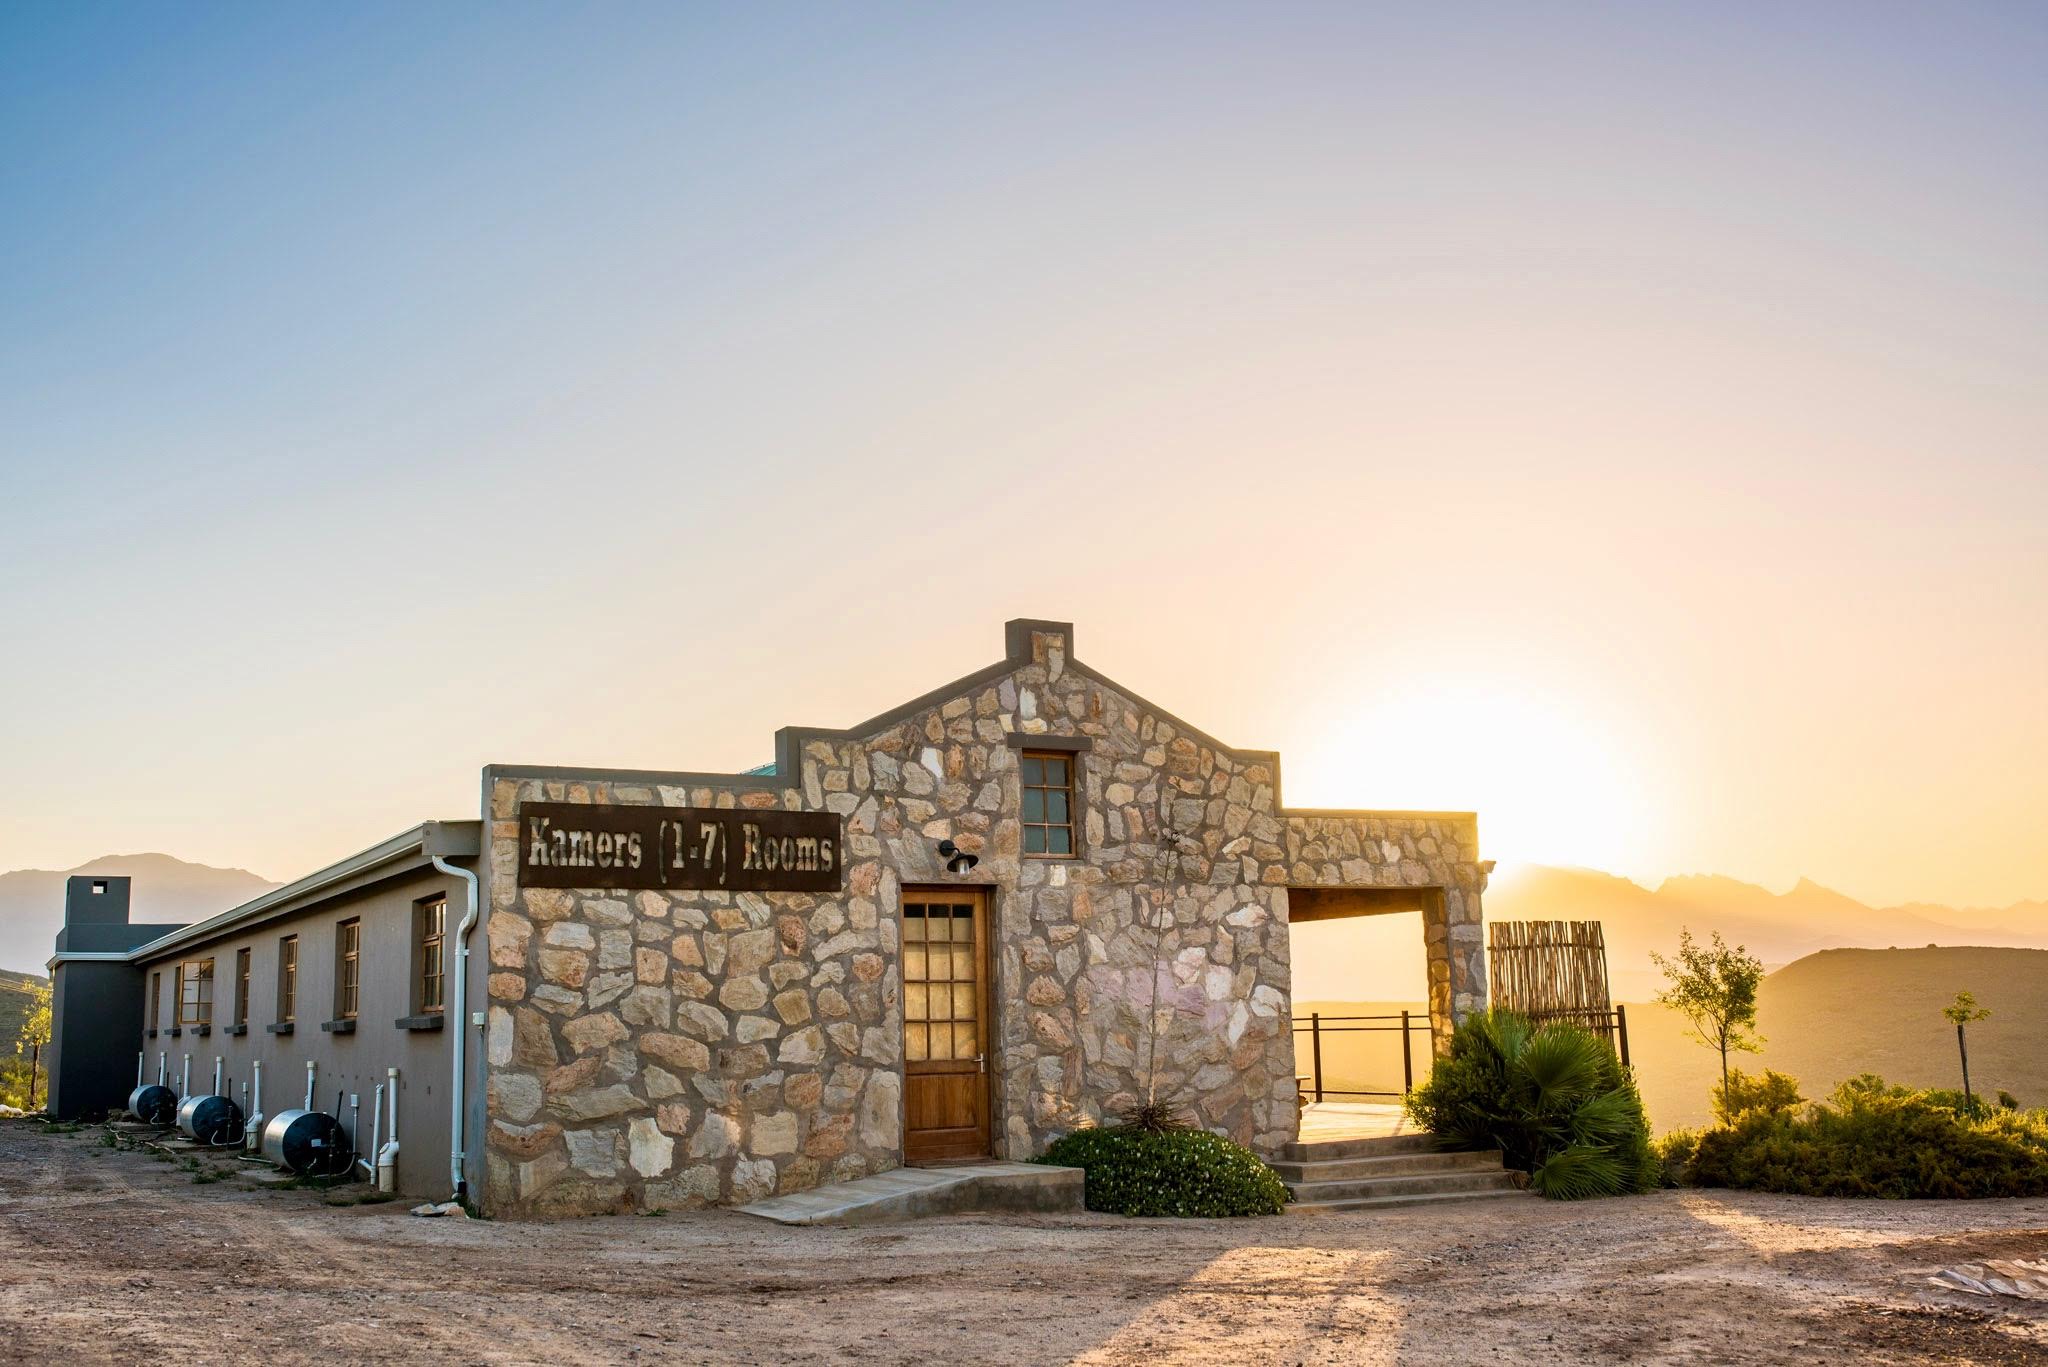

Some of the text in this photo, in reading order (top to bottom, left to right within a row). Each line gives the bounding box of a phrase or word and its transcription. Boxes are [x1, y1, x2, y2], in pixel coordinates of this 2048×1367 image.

[528, 817, 833, 885] Kamers (1-7) Rooms
